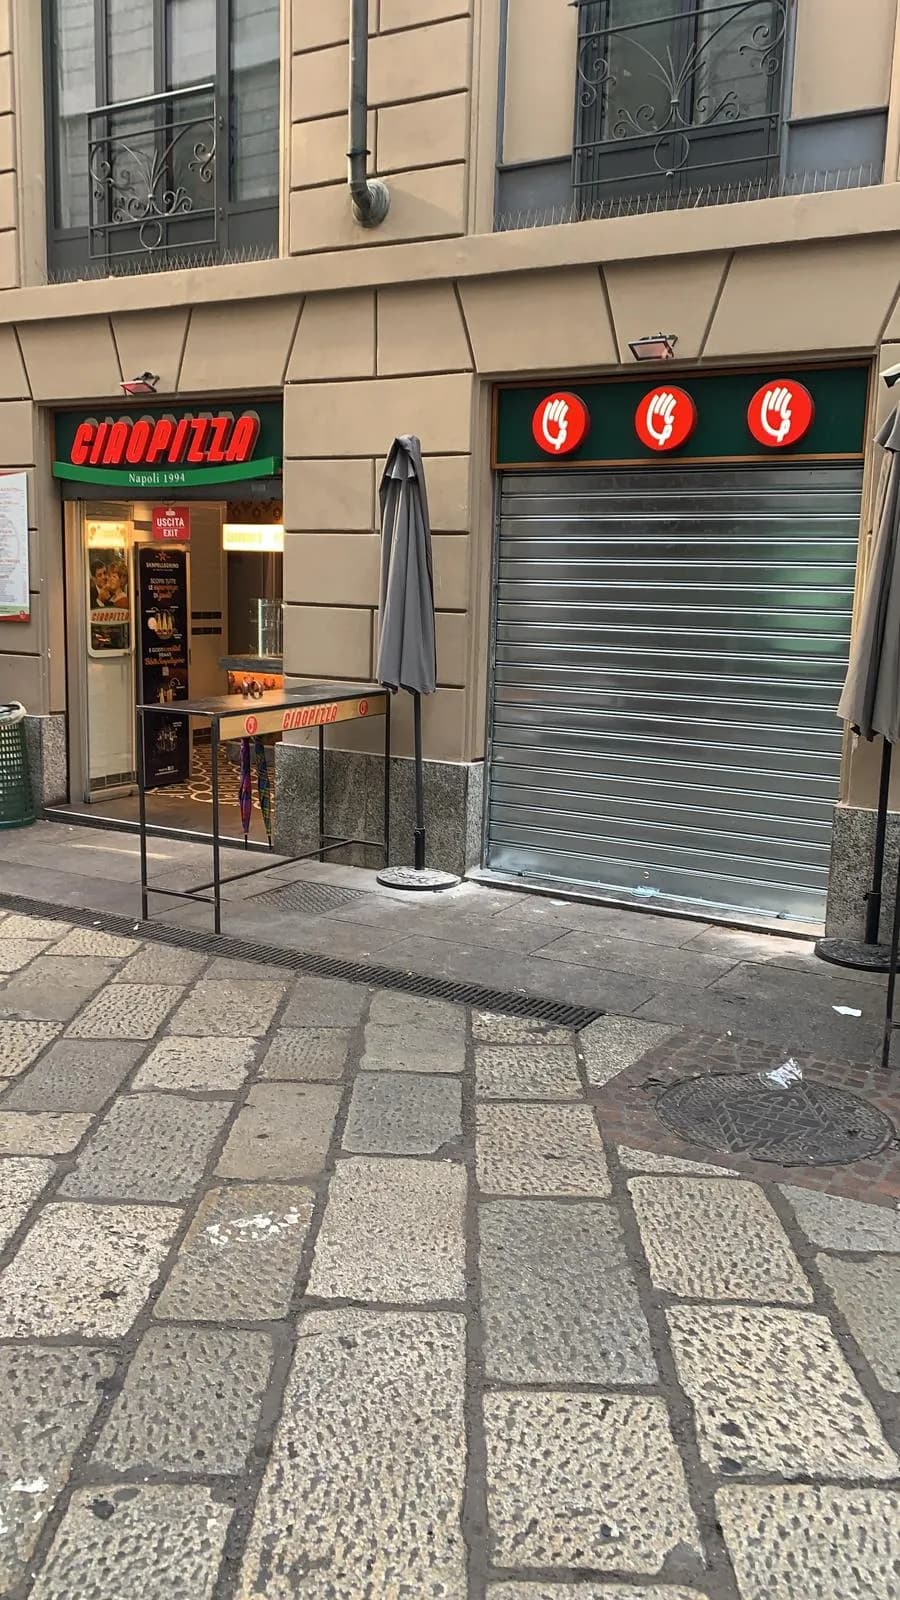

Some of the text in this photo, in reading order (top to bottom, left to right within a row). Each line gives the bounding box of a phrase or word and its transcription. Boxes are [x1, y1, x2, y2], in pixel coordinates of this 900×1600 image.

[70, 414, 257, 465] CIAOPIZZA
[128, 472, 186, 487] Napoli 1994
[156, 517, 185, 527] USCITA
[162, 528, 179, 537] EXIT
[282, 703, 339, 730] CIAOPIZZA
